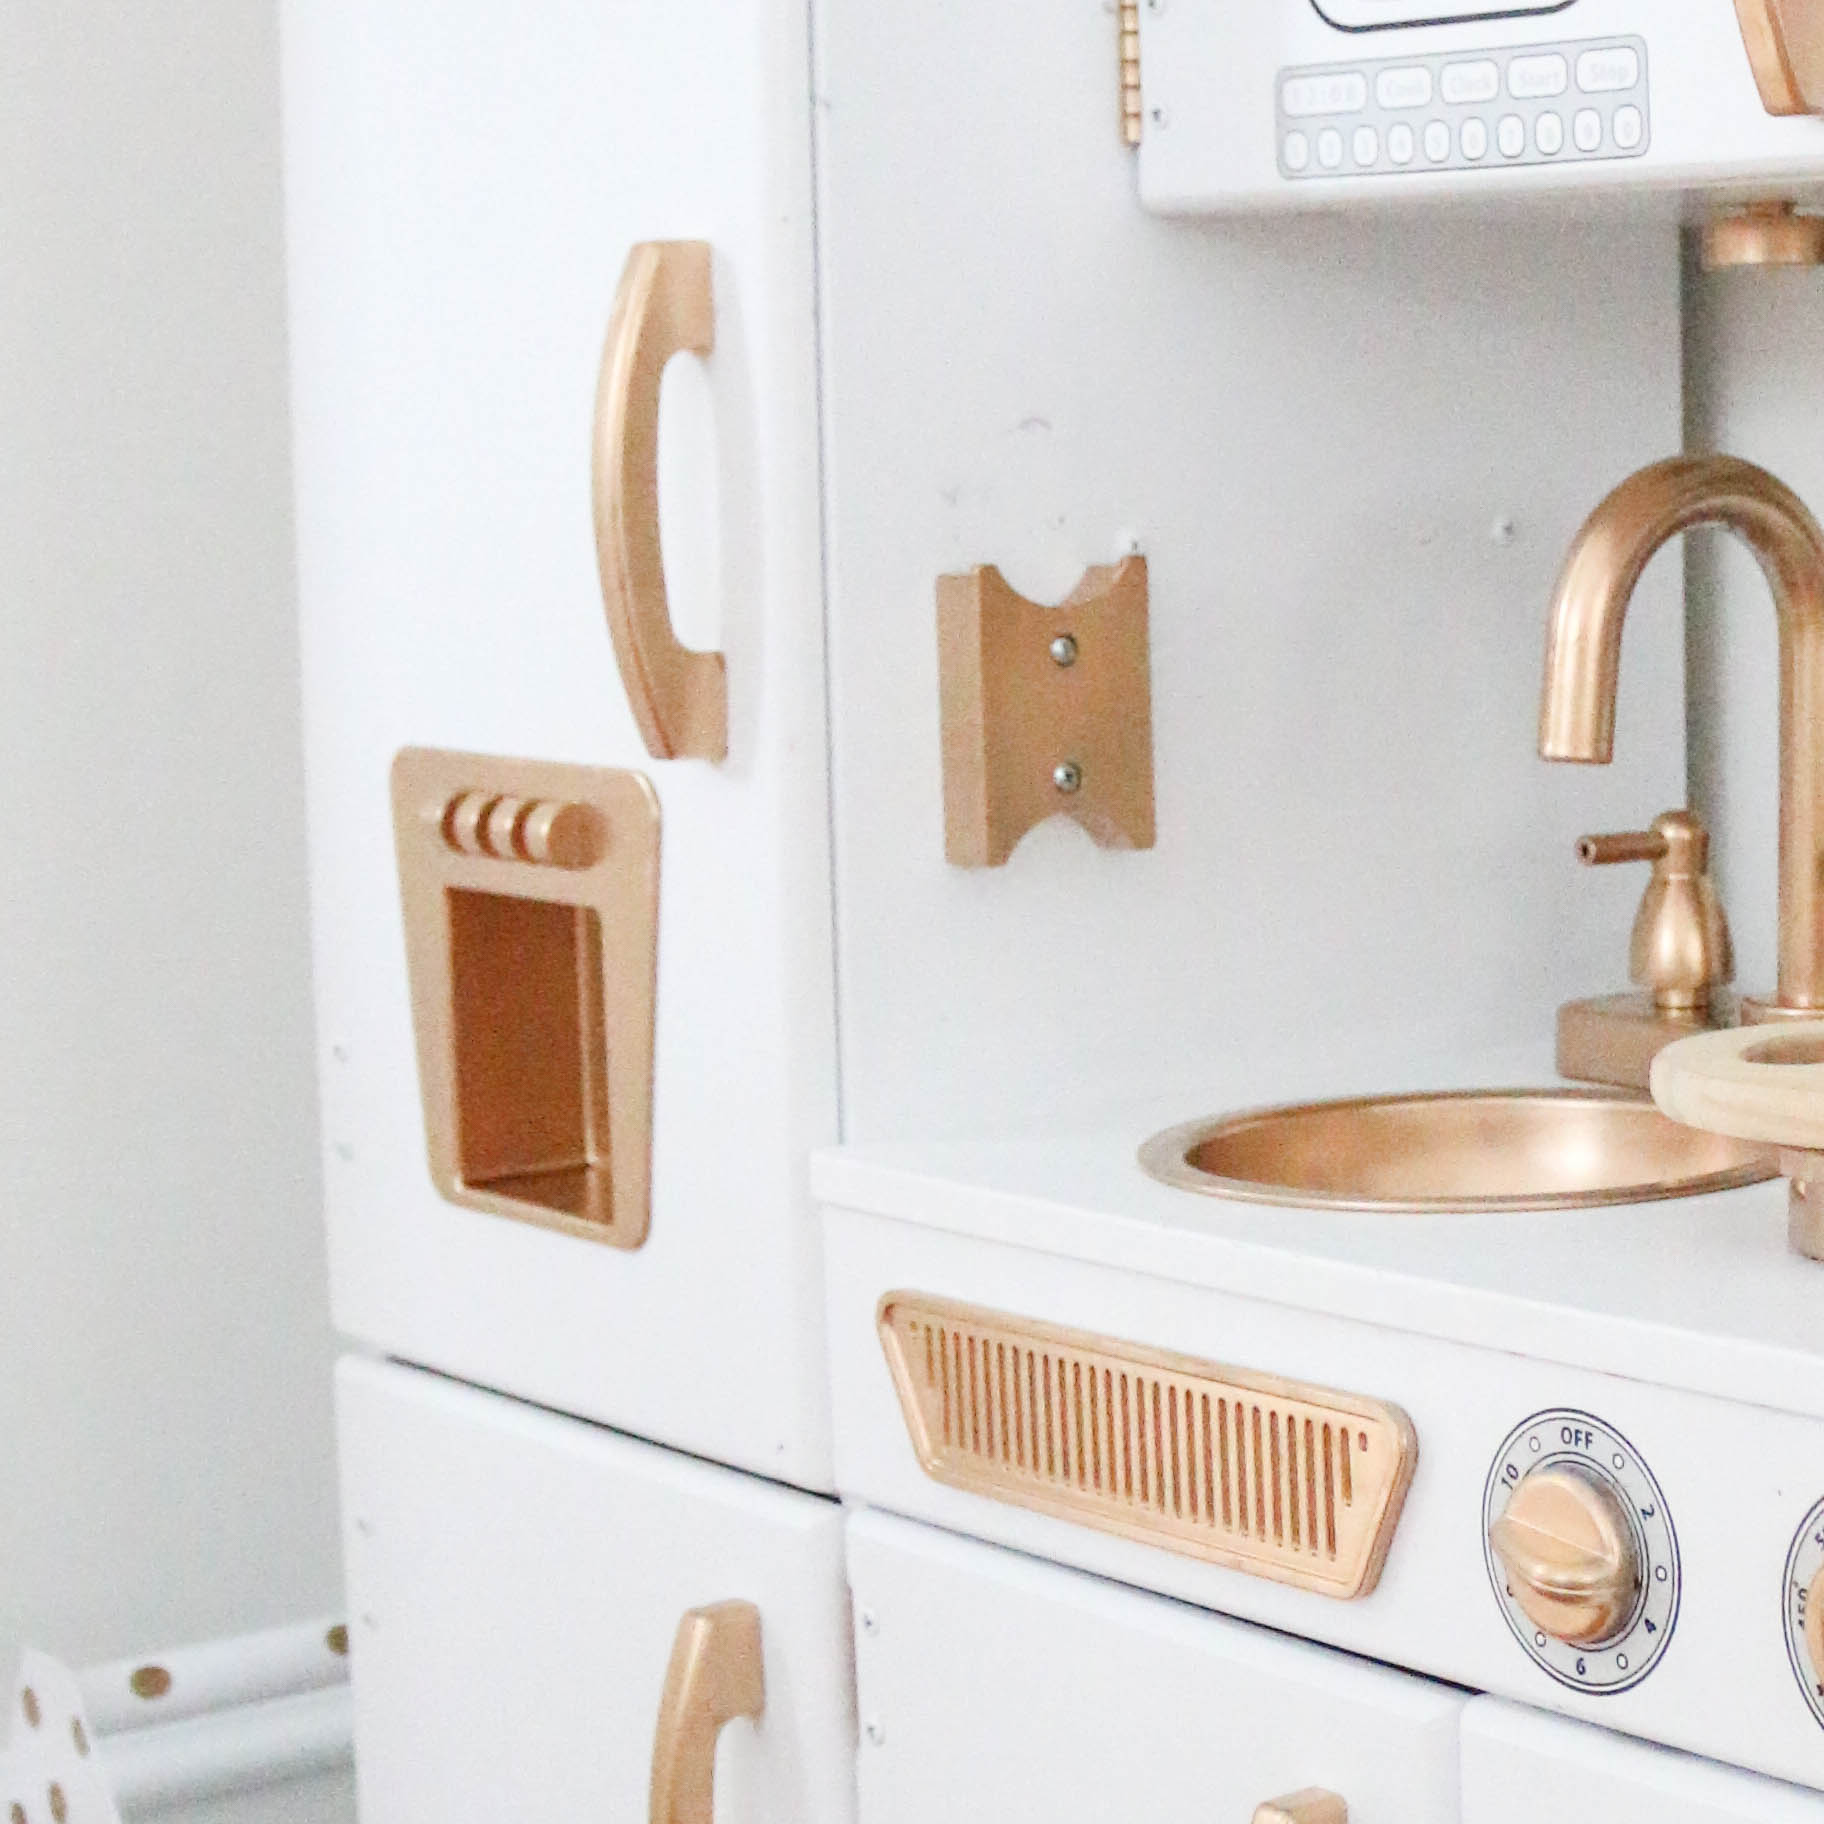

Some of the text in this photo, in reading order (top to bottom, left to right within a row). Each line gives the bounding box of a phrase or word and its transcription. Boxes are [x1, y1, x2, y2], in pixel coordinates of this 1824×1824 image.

[1560, 1426, 1594, 1450] OFF
[1501, 1463, 1519, 1490] 10
[1640, 1503, 1656, 1520] 2
[1643, 1617, 1658, 1634] 4
[1576, 1656, 1587, 1675] 6
